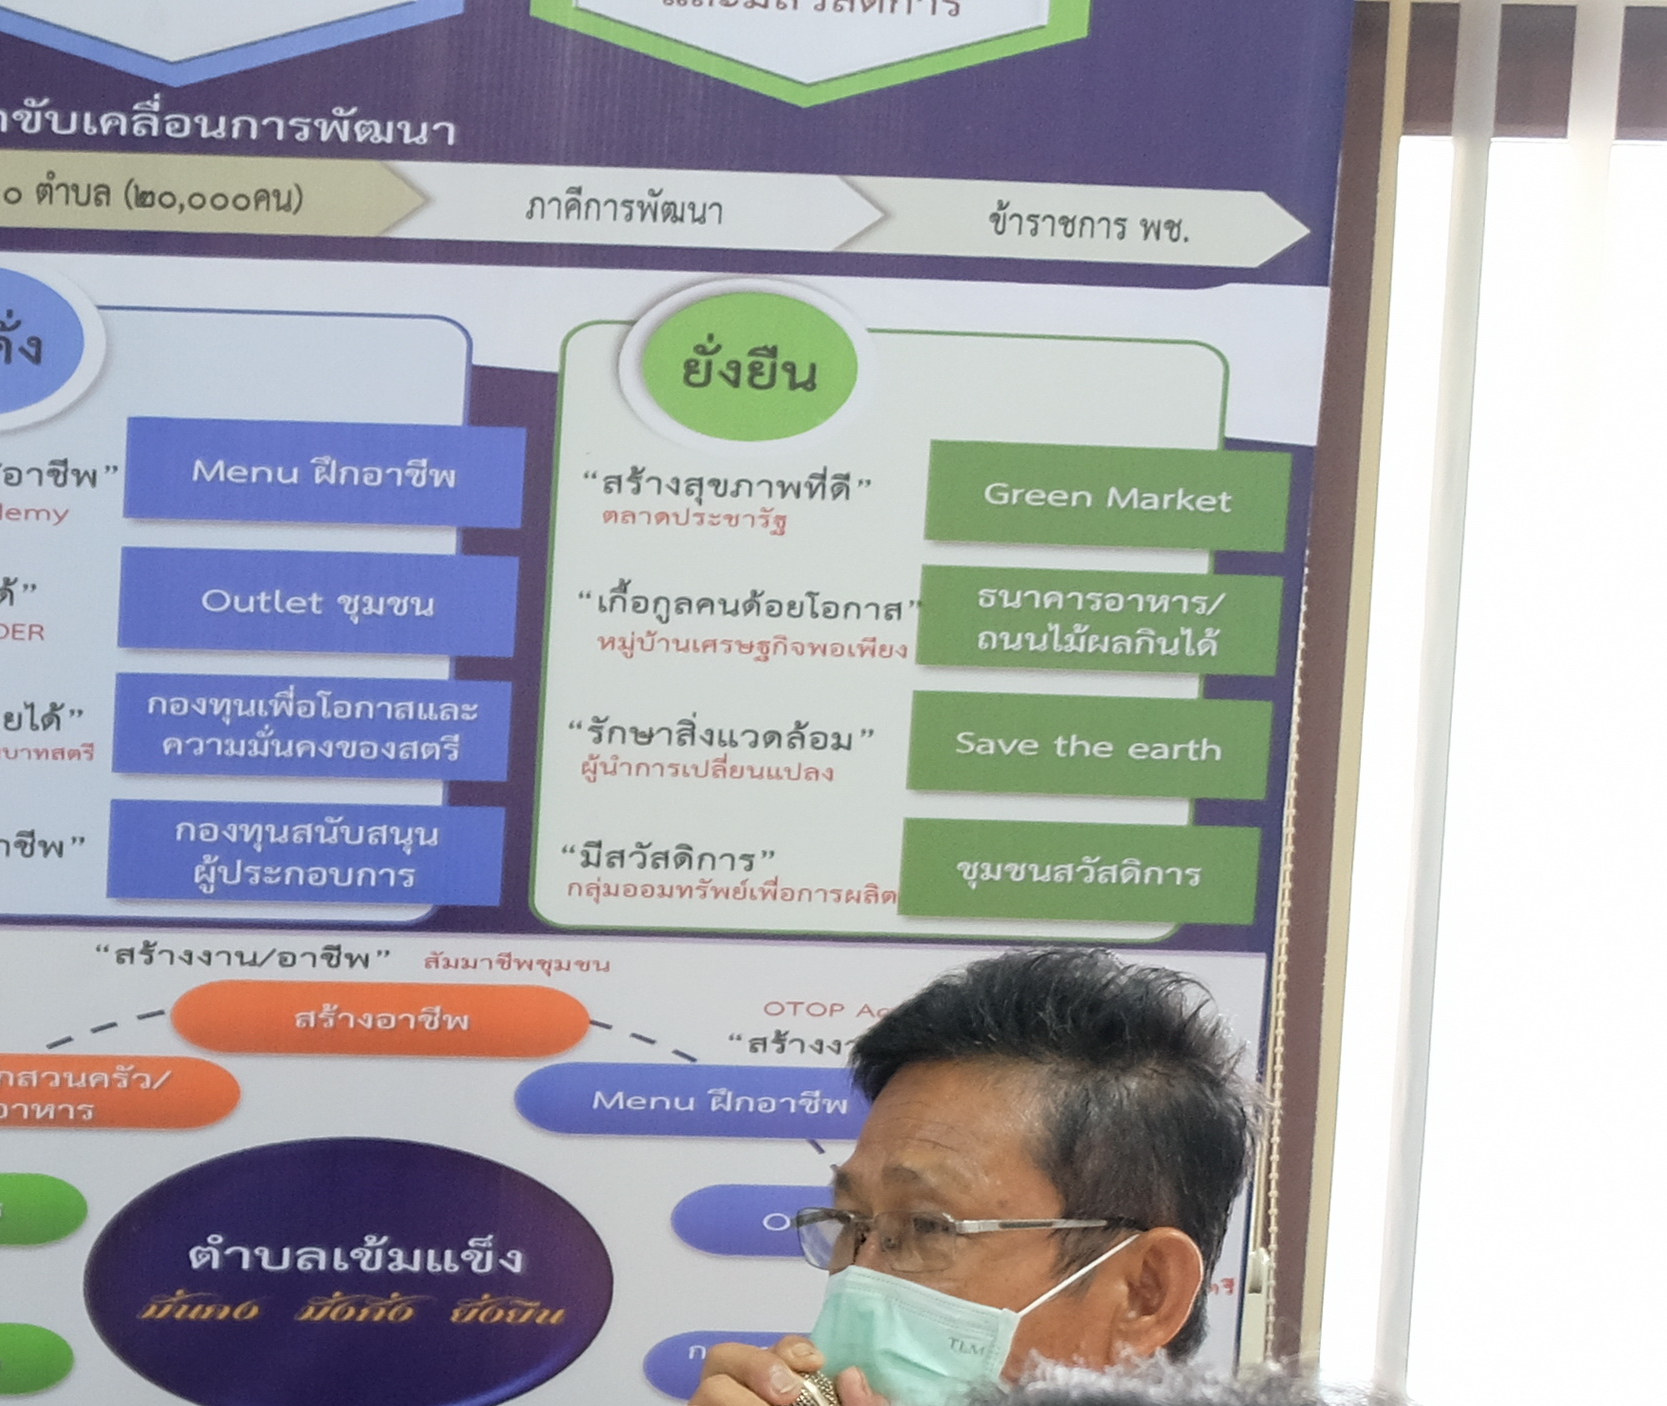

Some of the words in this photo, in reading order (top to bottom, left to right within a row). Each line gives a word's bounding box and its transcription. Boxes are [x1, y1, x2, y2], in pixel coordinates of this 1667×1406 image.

[36, 170, 111, 207] ตำบล
[124, 178, 303, 215] (๒๐,๐๐๐คน)
[526, 186, 722, 224] ภาคีการพัฒนา
[989, 200, 1127, 240] ข้าราชการ
[1140, 218, 1188, 243] พช.
[683, 333, 817, 392] ยั่งยืน
[193, 459, 298, 483] Menu
[310, 456, 455, 487] ฝึกอาชีพ
[985, 483, 1092, 507] Green
[1108, 487, 1232, 512] Market
[202, 589, 323, 614] Outlet
[337, 595, 434, 624] ชุมชน
[979, 589, 1226, 615] ธนาคารอาหาร/
[597, 630, 907, 662] หมู่บ้านเศรษฐกิจพอเพียง
[978, 622, 1220, 656] ถนนไม้ผลกินได้
[149, 685, 478, 728] กองทุนเพื่อโอกาสและ
[163, 727, 459, 761] ความมั่นคงของสตรี
[956, 732, 1039, 755] Save
[1054, 734, 1113, 757] the
[1128, 738, 1221, 760] earth
[582, 753, 833, 783] ผู้นำการเปลี่ยนแปลง
[176, 816, 438, 855] กองทุนสนับสนุน
[194, 852, 415, 894] ผู้ประกอบการ
[957, 856, 1201, 889] ชุมชนสวัสดิการ
[566, 876, 898, 908] กลุ่มออมทรัพย์เพื่อการผลิต
[425, 951, 610, 977] สัมมาชีพชุมชน
[296, 1003, 468, 1031] สร้างอาชีพ
[762, 1000, 845, 1018] OTOP
[593, 1091, 694, 1110] Menu
[707, 1088, 847, 1114] ฝึกอาชีพ
[189, 1234, 523, 1273] ตำบลเข้มแข็ง
